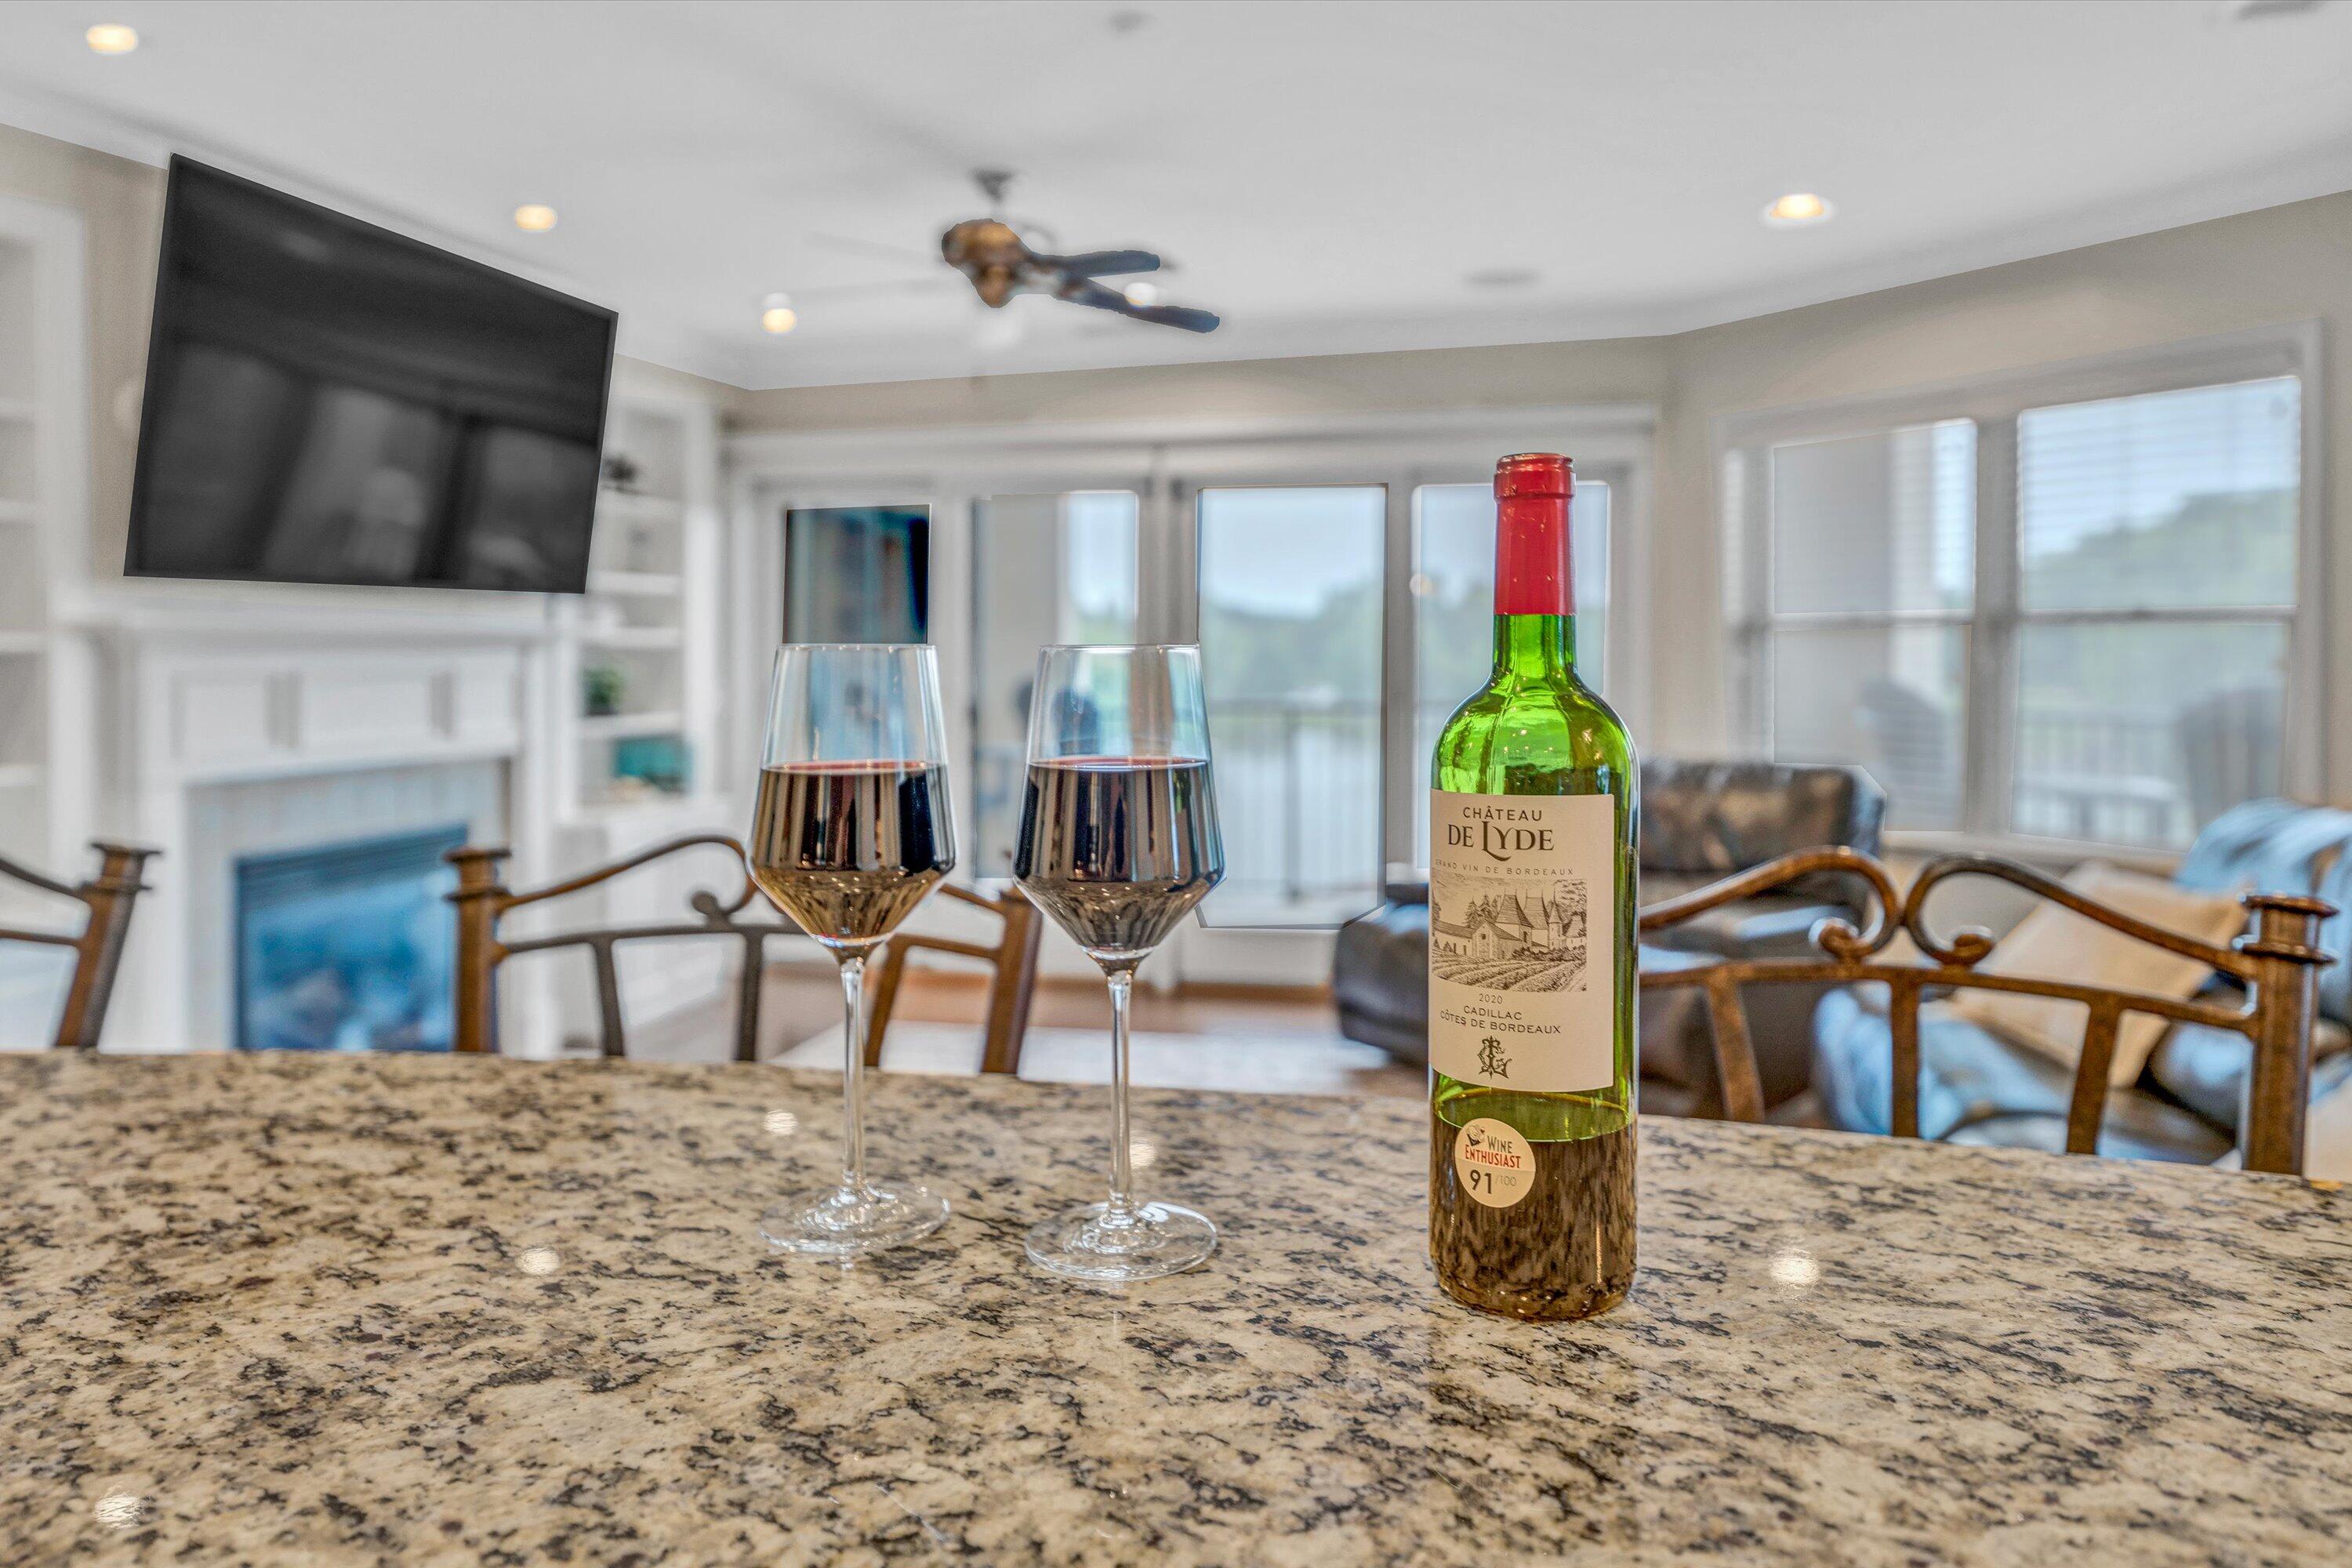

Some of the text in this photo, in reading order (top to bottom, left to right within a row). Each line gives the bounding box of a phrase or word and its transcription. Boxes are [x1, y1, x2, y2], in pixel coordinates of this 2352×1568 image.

[1463, 805, 1542, 821] CHÂTEAU
[1448, 821, 1554, 862] DE LYDE
[1507, 867, 1574, 876] BORDEAUX
[1479, 993, 1503, 1004] 2020
[1439, 1009, 1562, 1034] CÔTES DE BORDEAUX
[1463, 1005, 1523, 1020] CADILLAC
[1465, 1145, 1522, 1168] ENTHUSIAST
[1469, 1169, 1492, 1194] 91
